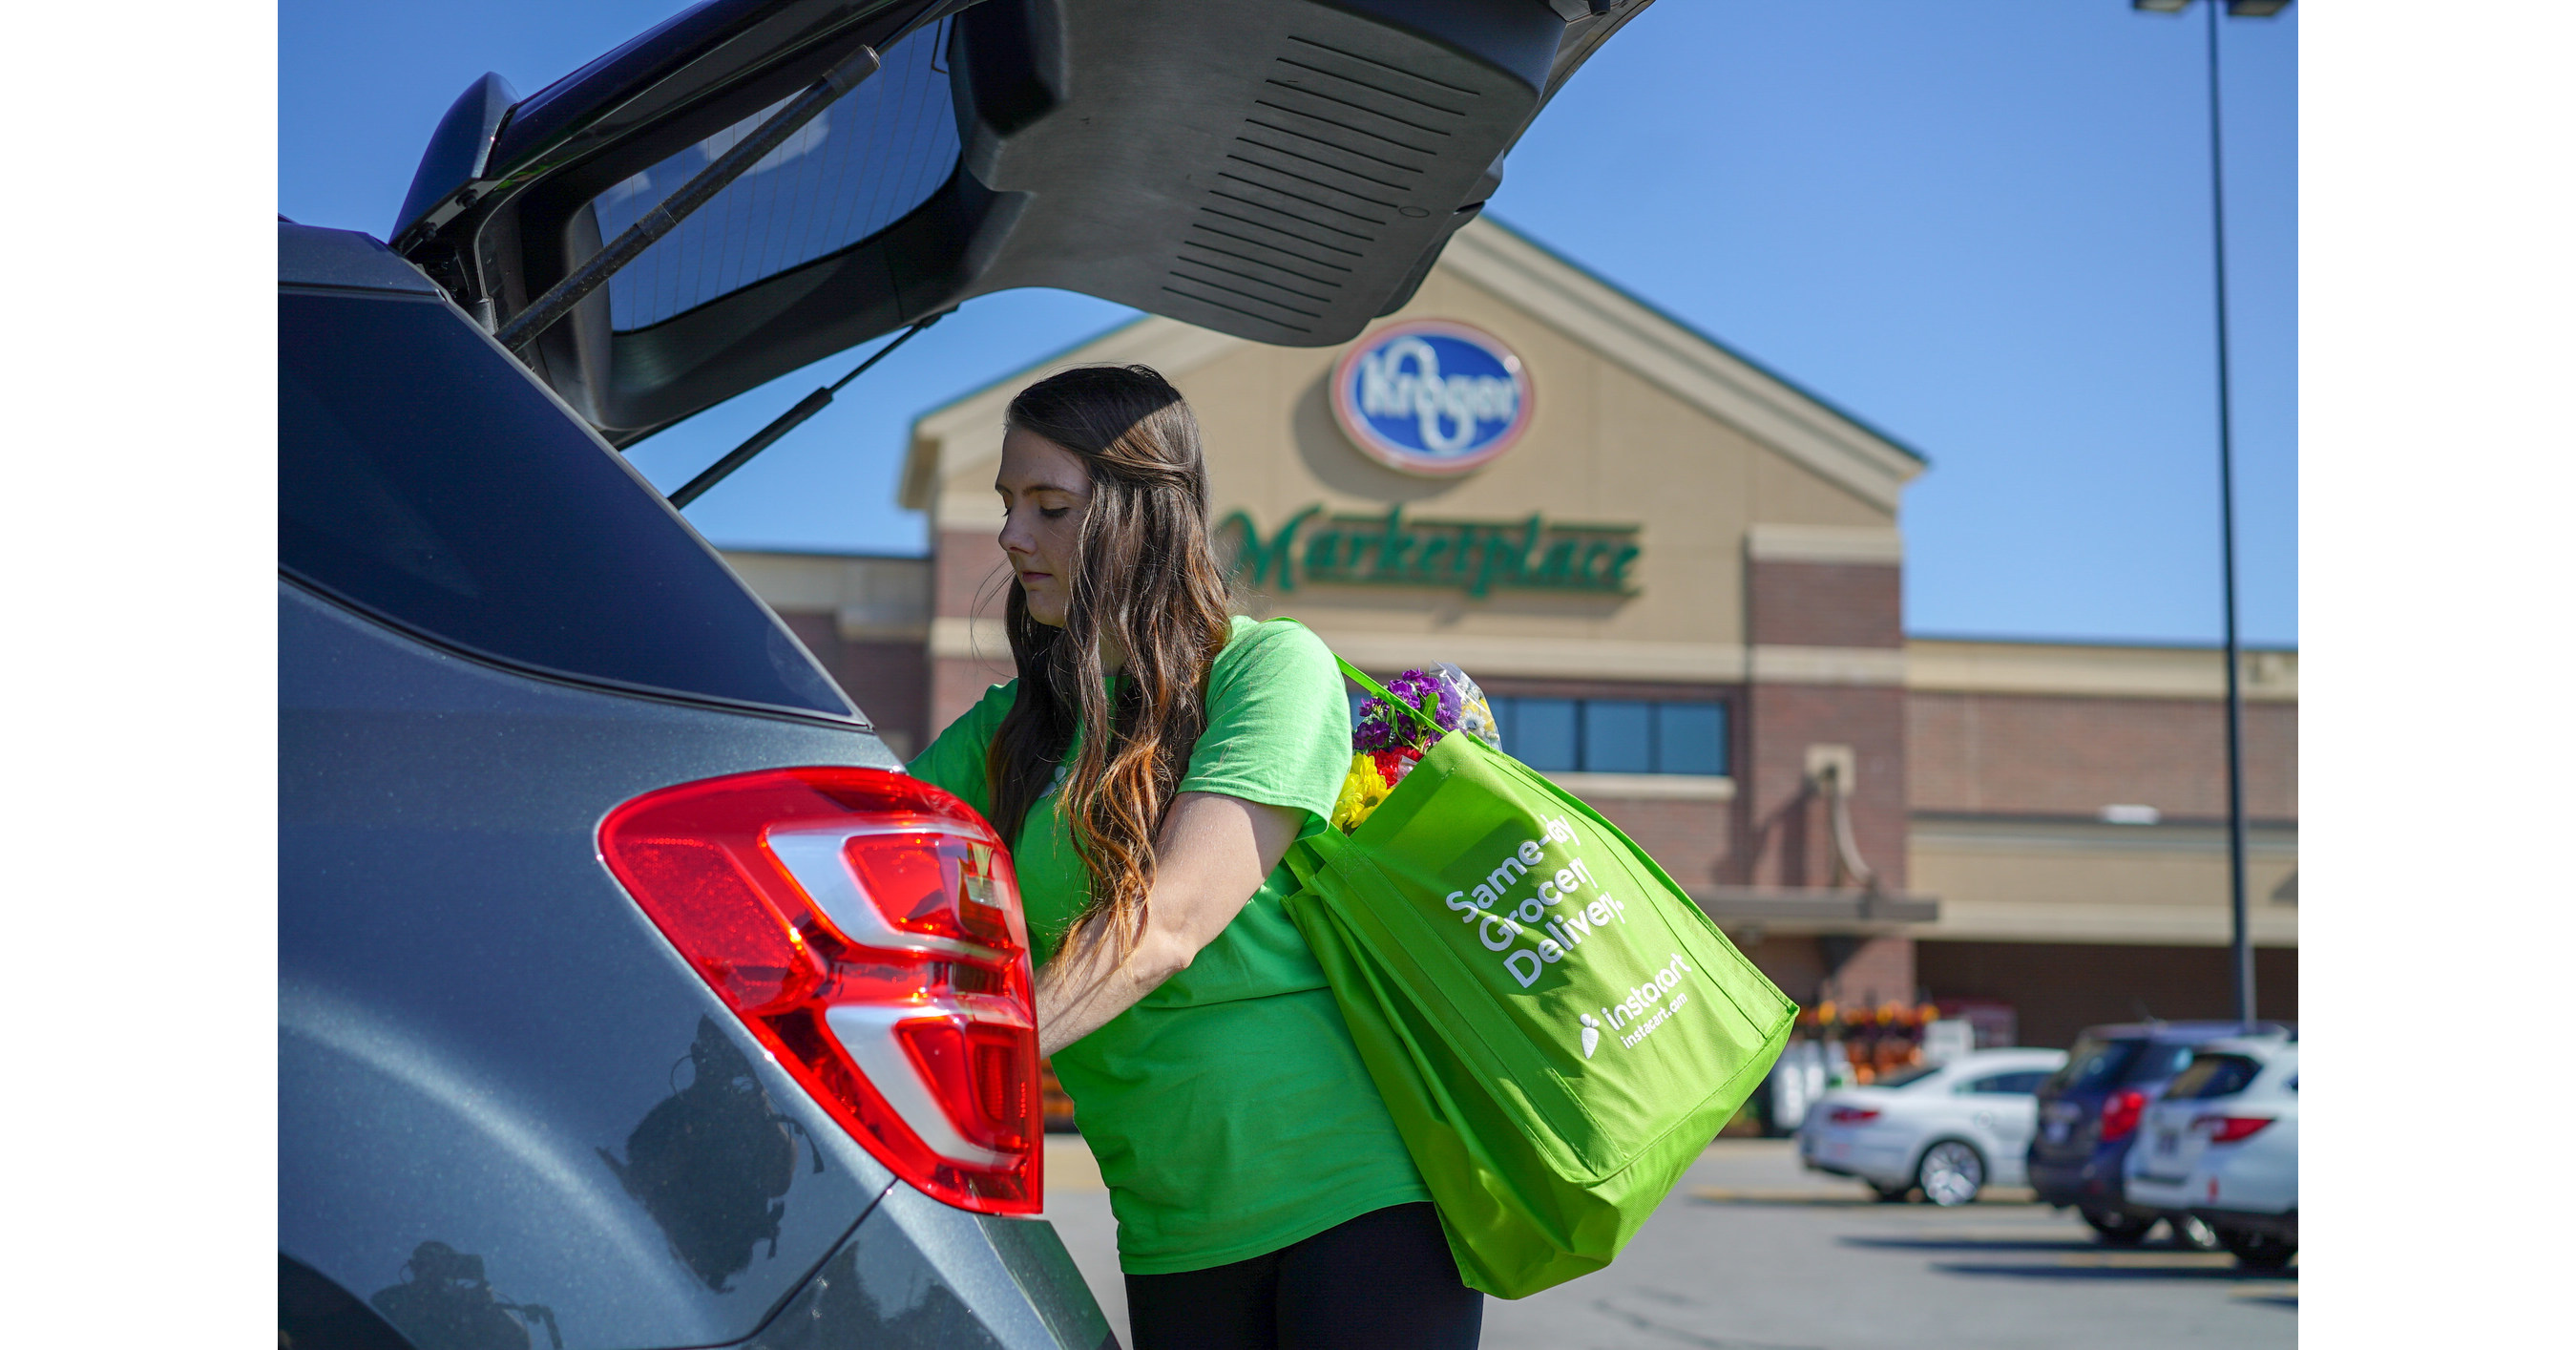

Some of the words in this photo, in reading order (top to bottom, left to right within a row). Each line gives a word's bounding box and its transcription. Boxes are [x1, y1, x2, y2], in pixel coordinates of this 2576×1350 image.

[1363, 336, 1518, 453] Kroger
[1217, 503, 1643, 598] Marketplace
[1601, 953, 1692, 1031] instacart
[1620, 992, 1688, 1049] instacart.com
